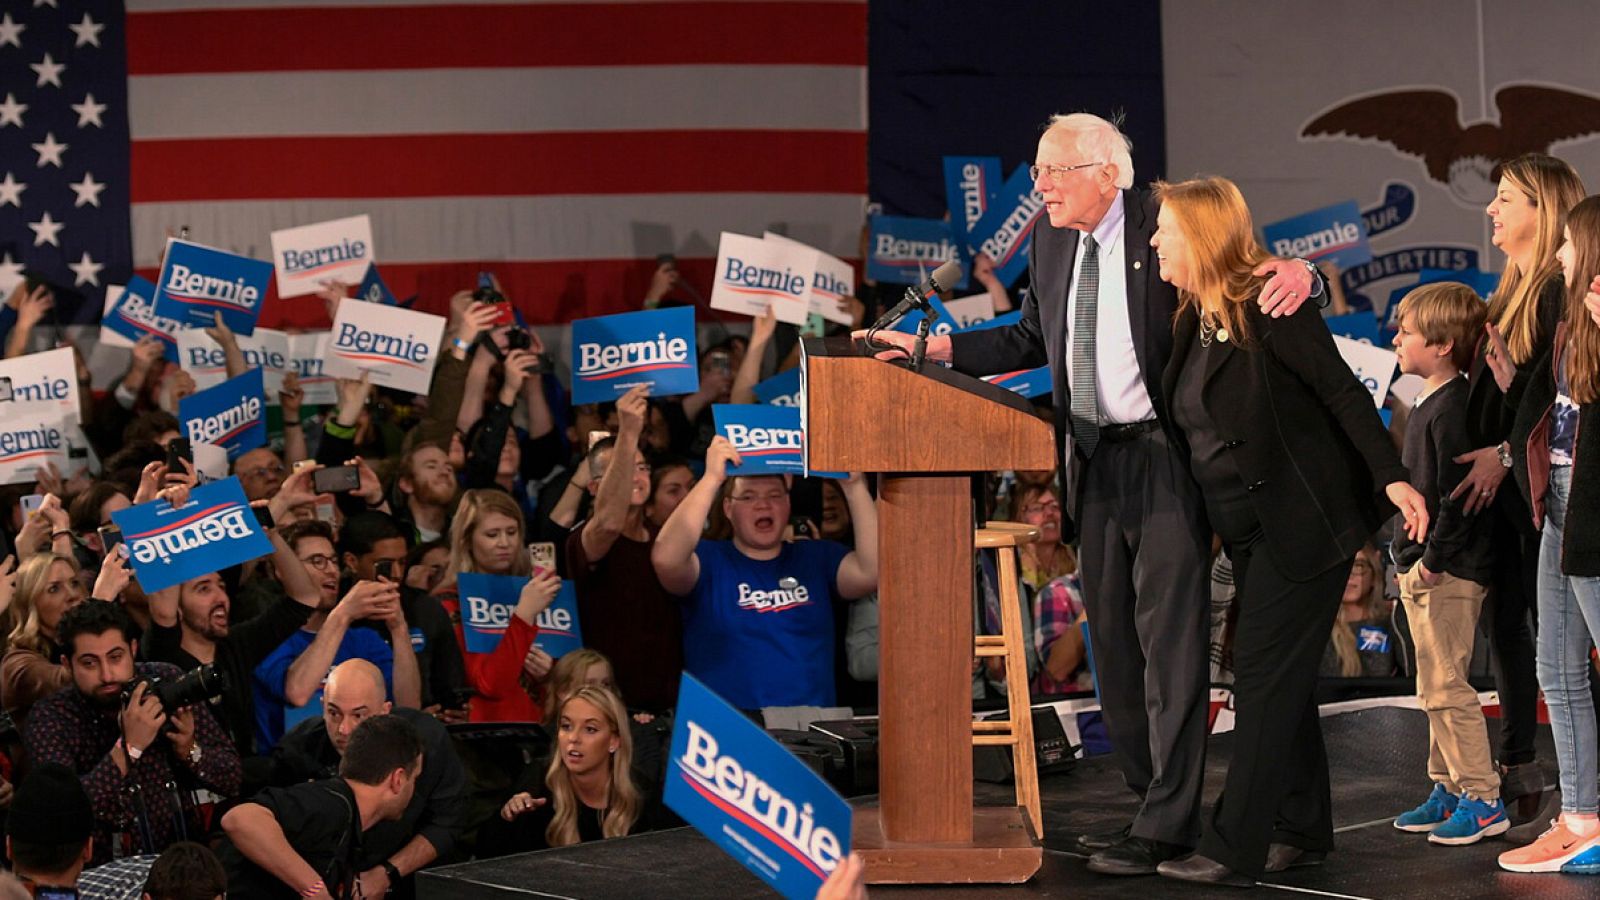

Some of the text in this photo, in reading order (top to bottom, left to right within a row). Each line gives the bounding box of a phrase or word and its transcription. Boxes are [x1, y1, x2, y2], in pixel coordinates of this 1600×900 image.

[960, 163, 982, 233] rnie
[980, 189, 1044, 263] Bernie
[1273, 221, 1359, 258] Bernie
[282, 237, 366, 271] Bernie
[1345, 250, 1469, 287] LIBERTIES
[167, 264, 258, 307] Bernie
[724, 256, 805, 295] Bernie
[813, 271, 849, 295] nie
[188, 345, 285, 369] Benie
[335, 322, 429, 363] Bernie
[578, 332, 688, 371] Bernie
[12, 375, 69, 401] rnie
[0, 423, 61, 454] ernie
[186, 395, 260, 445] Bernie
[723, 423, 801, 448] Bern
[133, 509, 254, 564] Bernie
[681, 720, 842, 873] Bernie
